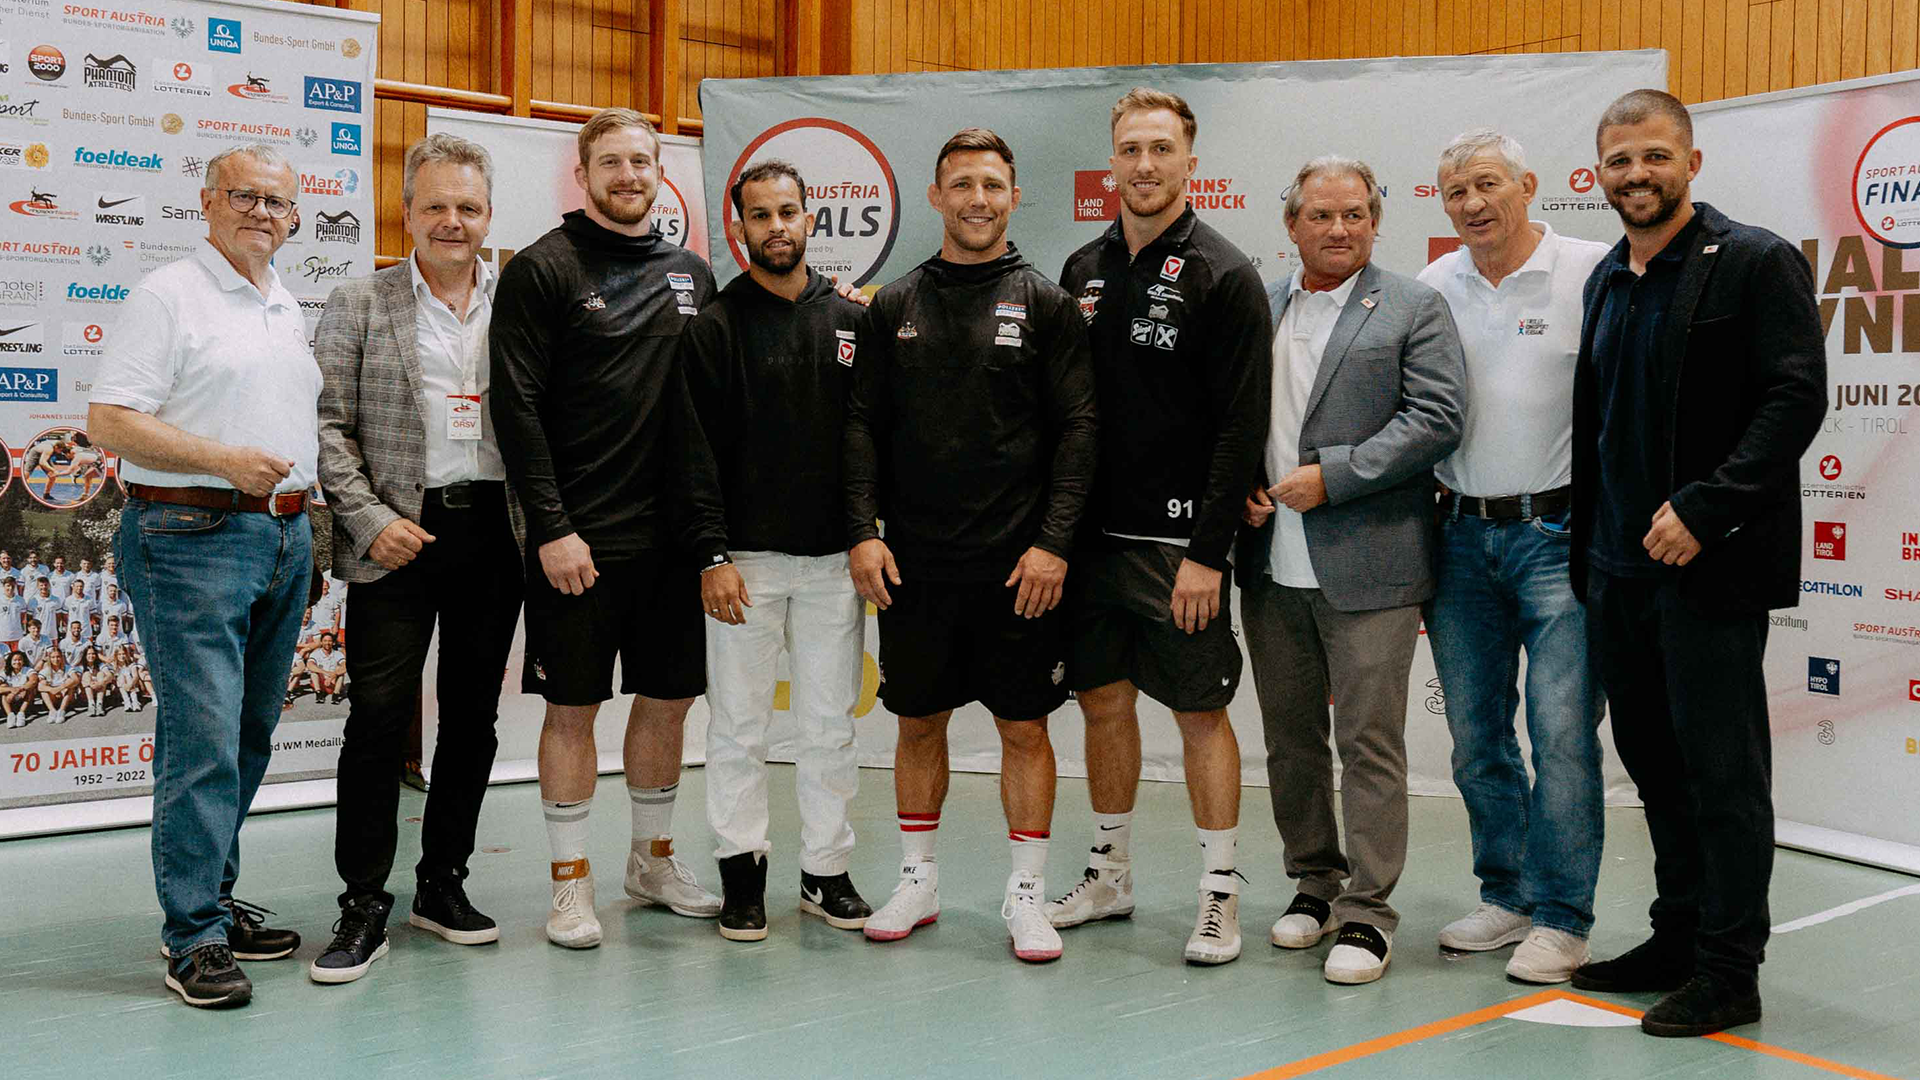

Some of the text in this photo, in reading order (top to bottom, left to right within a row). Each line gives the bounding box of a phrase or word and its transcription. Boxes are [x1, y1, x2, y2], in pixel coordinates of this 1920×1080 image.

[63, 5, 166, 27] SPORT AUSTRIA
[209, 38, 239, 49] UNIQA
[253, 31, 336, 51] Bundes-Sport GmbH
[30, 53, 64, 66] SPORT
[33, 64, 61, 73] 2000
[84, 66, 136, 90] PHANTOM
[88, 80, 132, 92] ATHLETICS
[154, 85, 211, 96] LOTTERIEN
[309, 82, 355, 101] AP&P
[62, 108, 125, 125] Bundes-Sport
[128, 117, 155, 127] GmbH
[197, 119, 291, 138] SPORT AUSTRIA
[332, 142, 359, 151] UNIQA
[75, 146, 163, 168] foeldeak
[1865, 165, 1906, 180] SPORT
[300, 173, 343, 190] Marx
[806, 181, 880, 200] AUSTRIA
[651, 204, 679, 215] STRIA
[1077, 198, 1104, 208] LAND
[1077, 208, 1105, 217] TIROL
[95, 213, 144, 226] WRESTLING
[806, 205, 882, 238] ALS
[315, 223, 361, 243] PHANTOM
[655, 218, 680, 237] LS
[320, 235, 357, 245] ATHLETICS
[22, 242, 81, 256] AUSTRIA
[303, 256, 353, 283] Sport
[0, 342, 43, 354] RESTLING
[1835, 384, 1888, 411] JUNI
[1861, 417, 1908, 434] TIROL
[1167, 498, 1193, 519] 91
[1815, 541, 1835, 550] LAND
[1902, 532, 1919, 546] IN
[1815, 549, 1835, 557] TIROL
[1853, 622, 1887, 634] SPORT
[1809, 675, 1829, 685] HYPO
[1809, 682, 1829, 692] TIROL
[283, 741, 302, 751] WM
[10, 752, 41, 774] 70
[49, 744, 130, 771] JAHRE
[73, 773, 103, 786] 1952
[116, 769, 146, 783] 2022
[557, 865, 575, 876] NIKE
[902, 865, 917, 875] NIKE
[1017, 881, 1036, 890] NIKE
